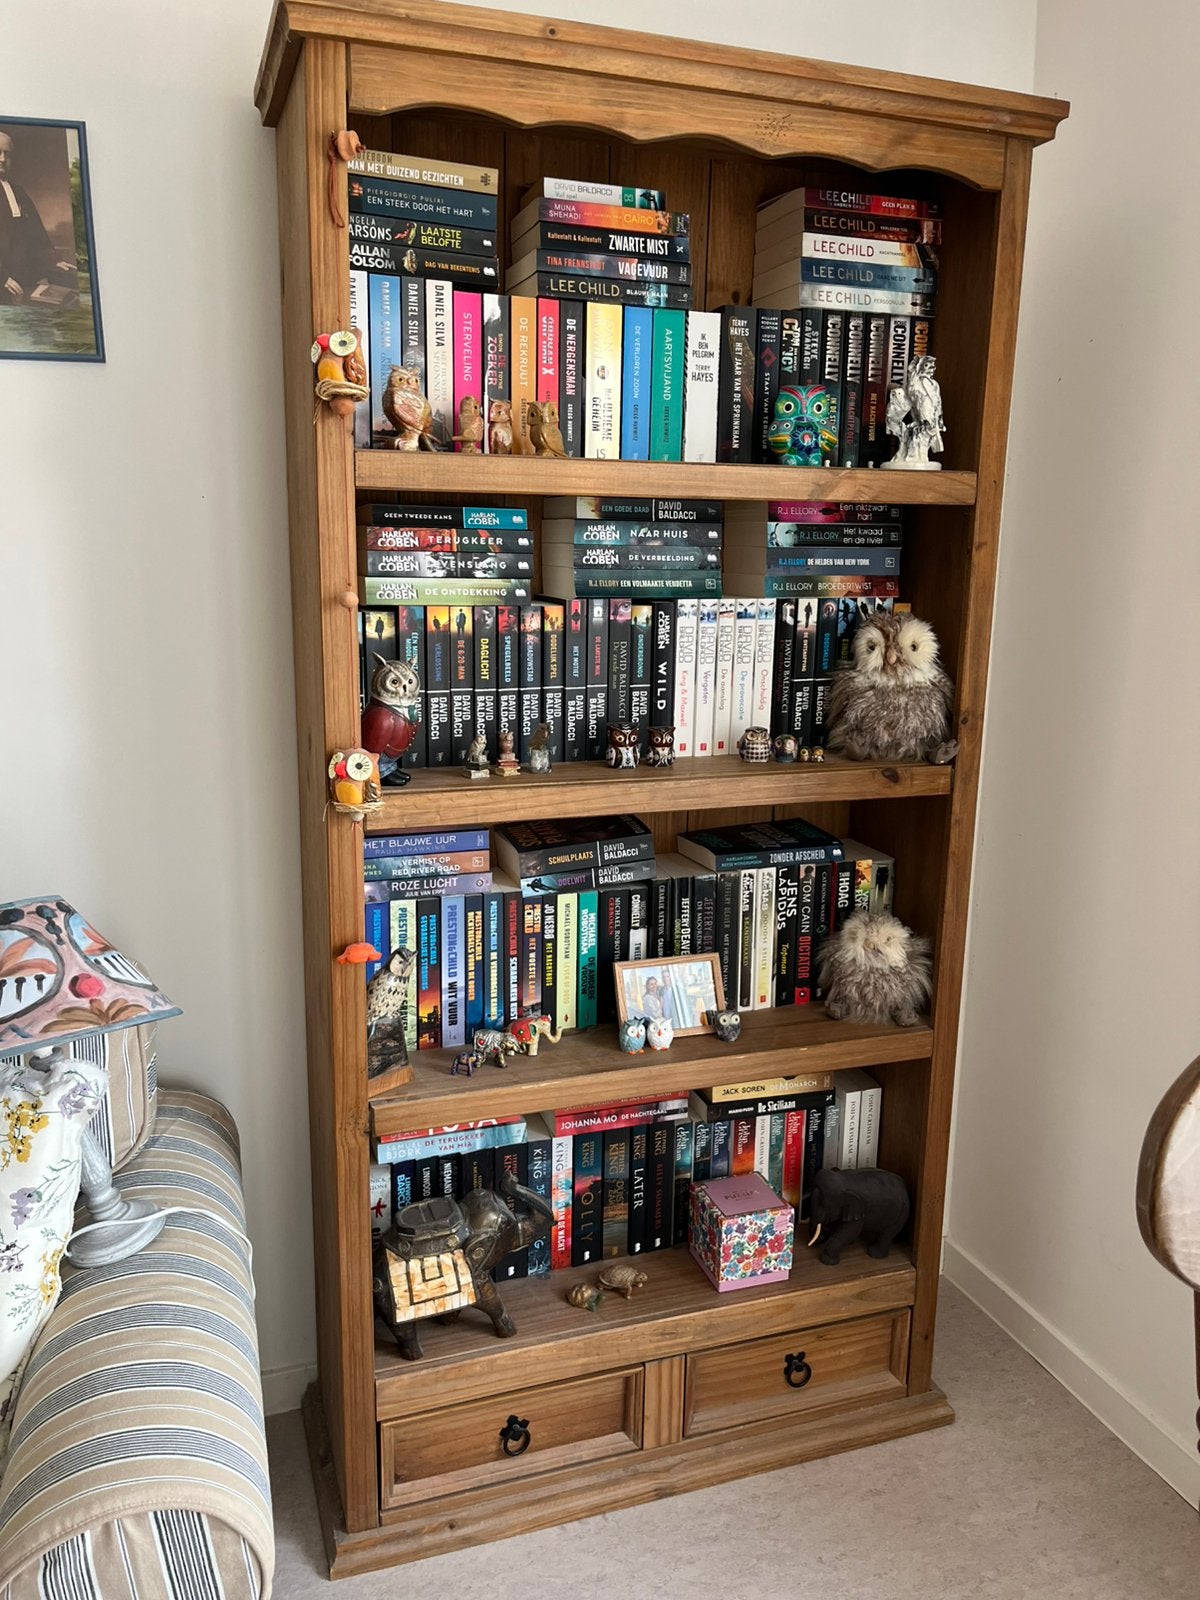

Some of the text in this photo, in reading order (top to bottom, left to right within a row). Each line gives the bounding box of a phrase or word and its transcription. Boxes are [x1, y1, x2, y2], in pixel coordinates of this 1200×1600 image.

[367, 163, 384, 173] MET
[423, 171, 464, 186] GEZICHTEN
[555, 183, 612, 196] DAVID BALDACCI
[367, 196, 473, 217] EEN STEEK DOOR HET HART
[549, 210, 581, 220] SHEHADI
[555, 204, 575, 212] MUNA
[814, 215, 875, 232] LEE CHILD
[421, 226, 461, 239] LAATSTE
[352, 244, 390, 258] ALLAN
[422, 236, 461, 249] BELOFTE
[609, 234, 669, 255] ZWARTE MIST
[814, 240, 874, 257] LEE CHILD
[618, 261, 668, 279] VAGEVUUR
[813, 266, 873, 282] LEE CHILD
[550, 279, 620, 296] LEE CHILD
[381, 281, 390, 315] DANIEL
[811, 291, 871, 305] LEE CHILD
[408, 283, 418, 345] DANIEL SILVA
[435, 285, 445, 347] DANIEL SILVA
[381, 319, 391, 348] SILVA
[730, 327, 749, 336] HAYES
[463, 313, 472, 381] STERVELING
[519, 318, 528, 386] DE REKRUUT
[698, 341, 708, 349] BEN
[804, 320, 812, 370] CAVANAGH
[811, 331, 819, 360] STEVE
[825, 318, 841, 382] CONNELLY
[847, 321, 863, 384] CONNELLY
[488, 337, 497, 385] ZOEKER
[566, 319, 576, 395] DE NERGENSMAN
[692, 351, 714, 359] PELGRIM
[663, 329, 672, 400] AARTSVIJAND
[692, 373, 713, 382] HAYES
[734, 392, 741, 401] DE
[732, 404, 740, 448] SPRINKHAAN
[659, 502, 681, 510] DAVID
[659, 510, 696, 519] BALDACCI
[378, 538, 419, 547] COBEN
[428, 536, 503, 545] TERUGKEER
[584, 531, 620, 540] COBEN
[630, 530, 659, 538] NAAR
[855, 536, 864, 544] de
[583, 555, 619, 564] COBEN
[377, 589, 418, 599] COBEN
[481, 639, 489, 680] DAGLICHT
[658, 661, 667, 710] WILD
[702, 671, 711, 704] Vergeten
[439, 697, 447, 722] DAVID
[454, 695, 462, 737] BALDACCI
[462, 695, 471, 720] DAVID
[431, 698, 439, 739] BALDACCI
[365, 836, 456, 849] HET BLAUWE UUR
[604, 843, 624, 852] DAVID
[402, 858, 437, 866] VERMIST
[549, 851, 593, 865] SCHUILPLAATS
[604, 848, 638, 860] BALDACCI
[770, 849, 825, 864] ZONDER AFSCHEID
[392, 868, 409, 876] RED
[599, 872, 634, 884] BALDACCI
[392, 878, 458, 891] ROZE LUCHT
[838, 877, 850, 908] HOAG
[777, 868, 788, 930] LAPIDUS
[786, 879, 798, 918] JENS
[801, 879, 813, 933] TOM CAIN
[588, 913, 596, 947] MICHAEL
[588, 957, 595, 967] DE
[798, 936, 811, 979] DICTATOR
[448, 981, 458, 1026] WIT VUUR
[722, 1085, 765, 1096] JACK SOREN
[630, 1109, 667, 1119] NACHTEGAAL
[758, 1101, 796, 1113] De Siciliaan
[561, 1115, 618, 1130] JOHANNA MO
[438, 1132, 485, 1144] TERUGKEER
[533, 1149, 542, 1179] KING
[556, 1142, 564, 1171] KING
[609, 1144, 618, 1175] KING
[634, 1168, 644, 1210] LATER
